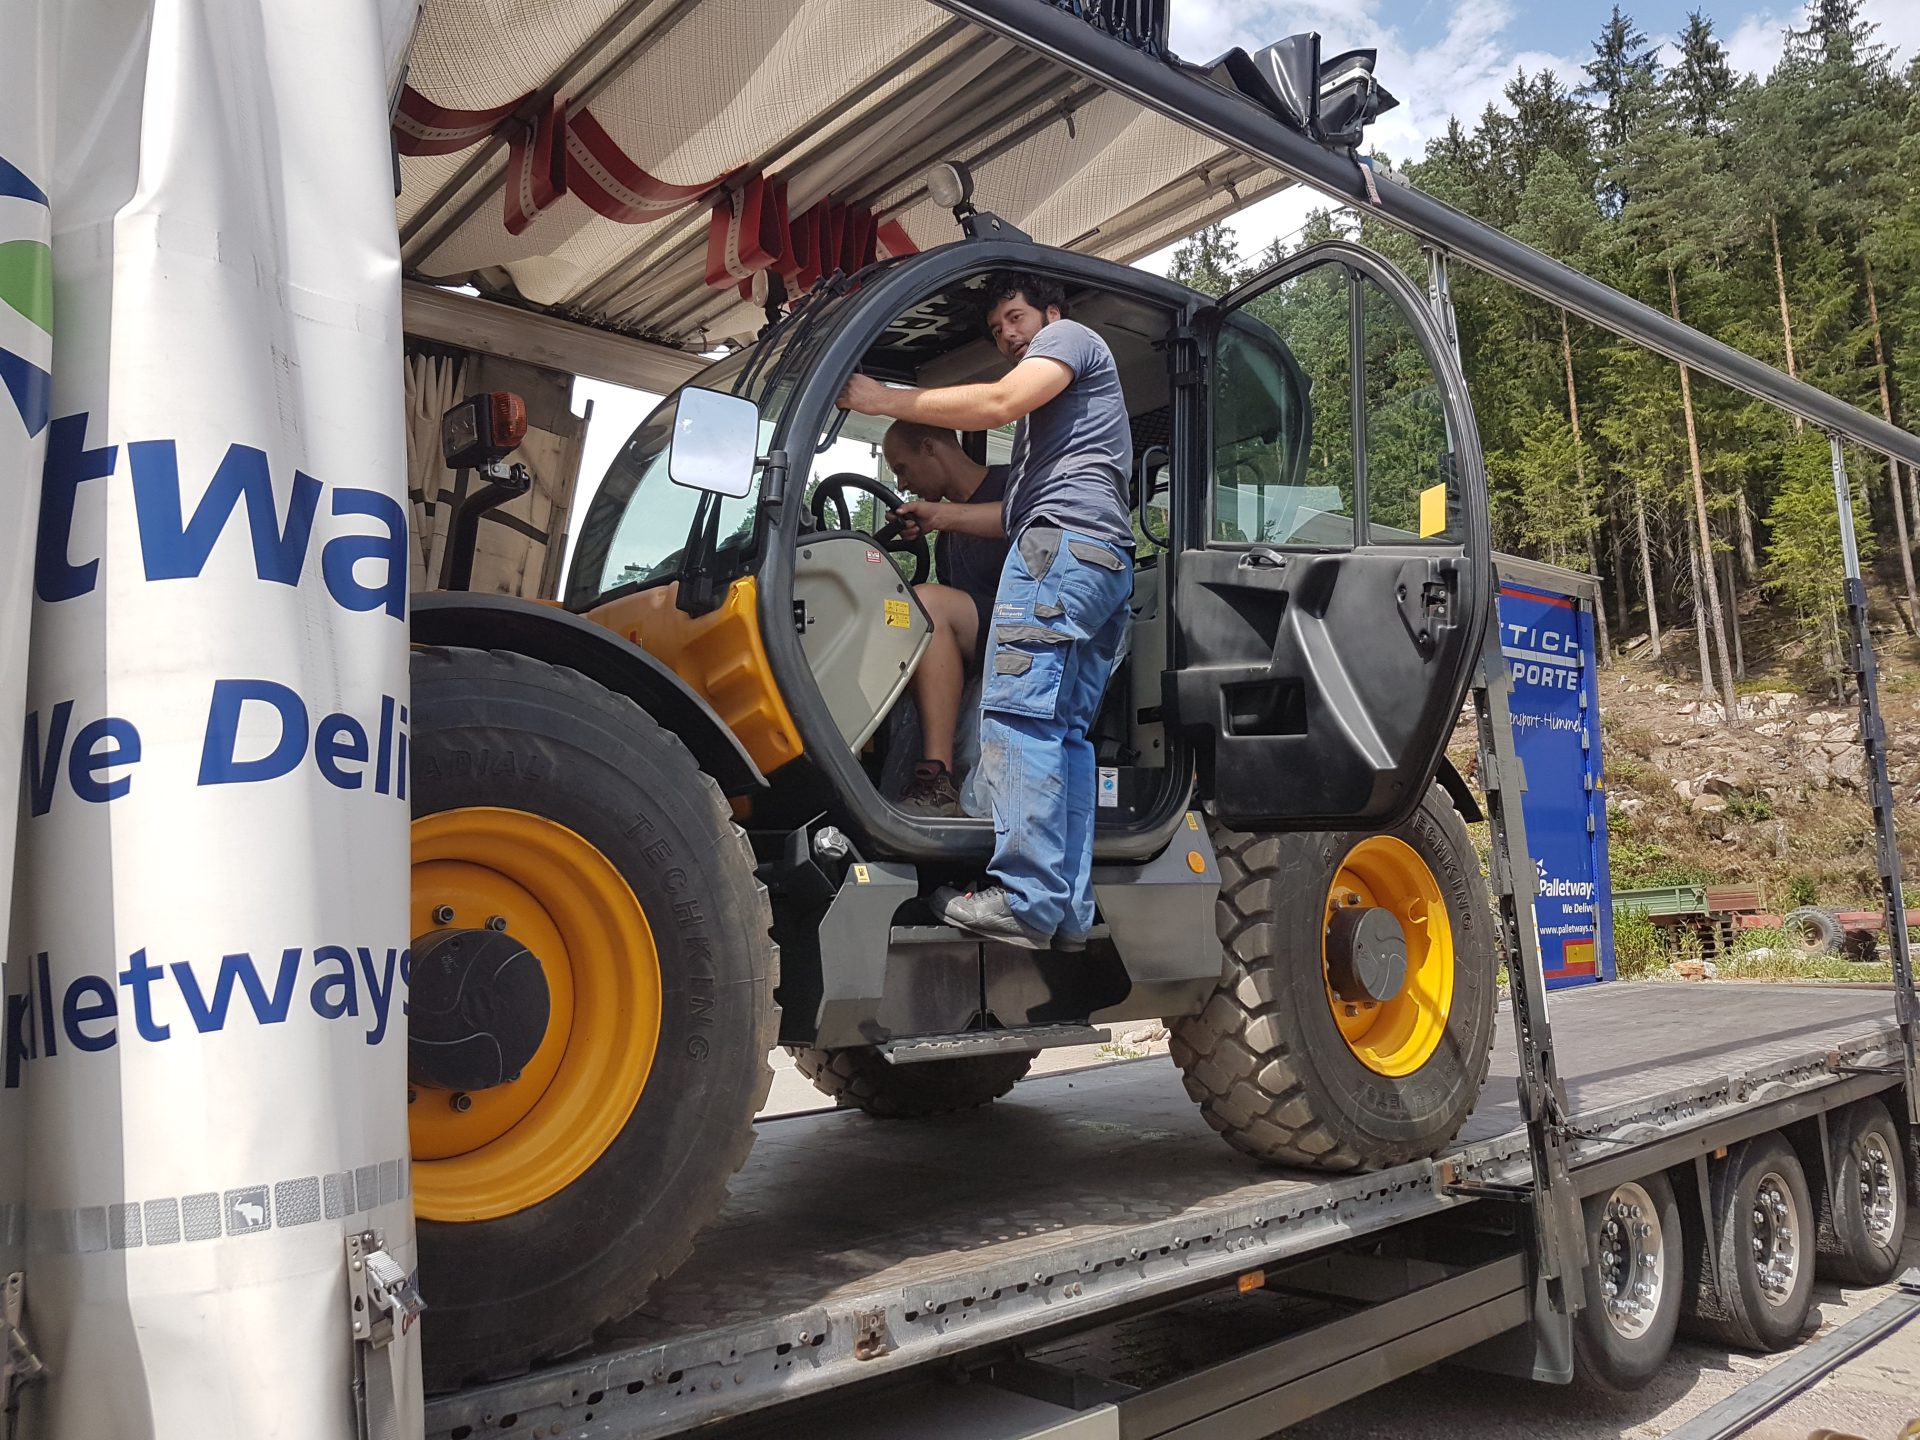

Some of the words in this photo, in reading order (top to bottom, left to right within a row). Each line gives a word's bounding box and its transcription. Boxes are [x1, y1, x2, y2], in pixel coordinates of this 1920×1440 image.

[1501, 622, 1578, 653] TICH
[1512, 662, 1578, 691] PORTE
[1413, 812, 1474, 932] ECHKING
[1562, 903, 1573, 914] We
[624, 811, 715, 1063] TECHKING
